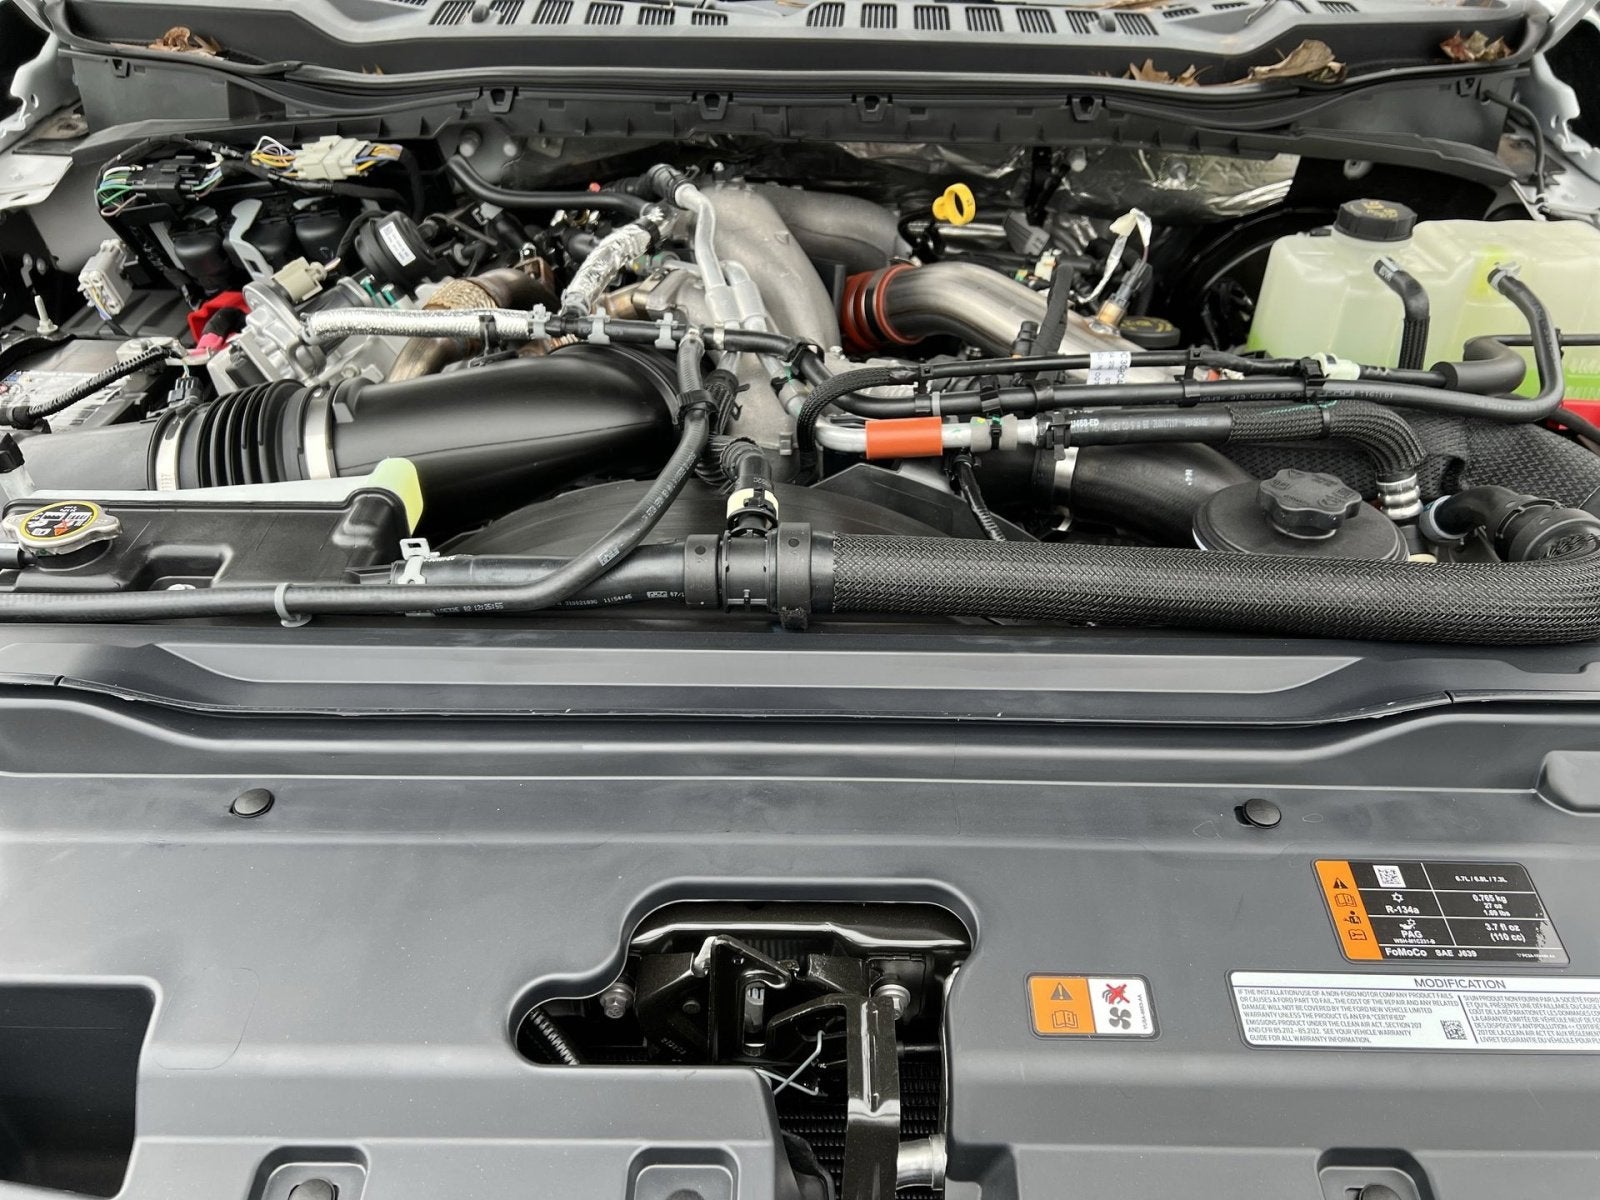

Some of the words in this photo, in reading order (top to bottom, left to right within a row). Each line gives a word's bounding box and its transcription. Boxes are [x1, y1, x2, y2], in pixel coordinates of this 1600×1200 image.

[1472, 894, 1495, 902] 0.765
[1495, 895, 1507, 904] kg
[1385, 905, 1420, 914] R-134a
[1485, 923, 1497, 931] 3.7
[1500, 923, 1508, 931] fl
[1401, 930, 1423, 939] PAG
[1490, 932, 1510, 943] (110
[1511, 933, 1526, 943] cc)
[1385, 947, 1428, 957] FoMoCo
[1435, 949, 1454, 957] SAE
[1414, 978, 1506, 989] MODIFICATION
[1376, 1029, 1412, 1037] WARRANTY
